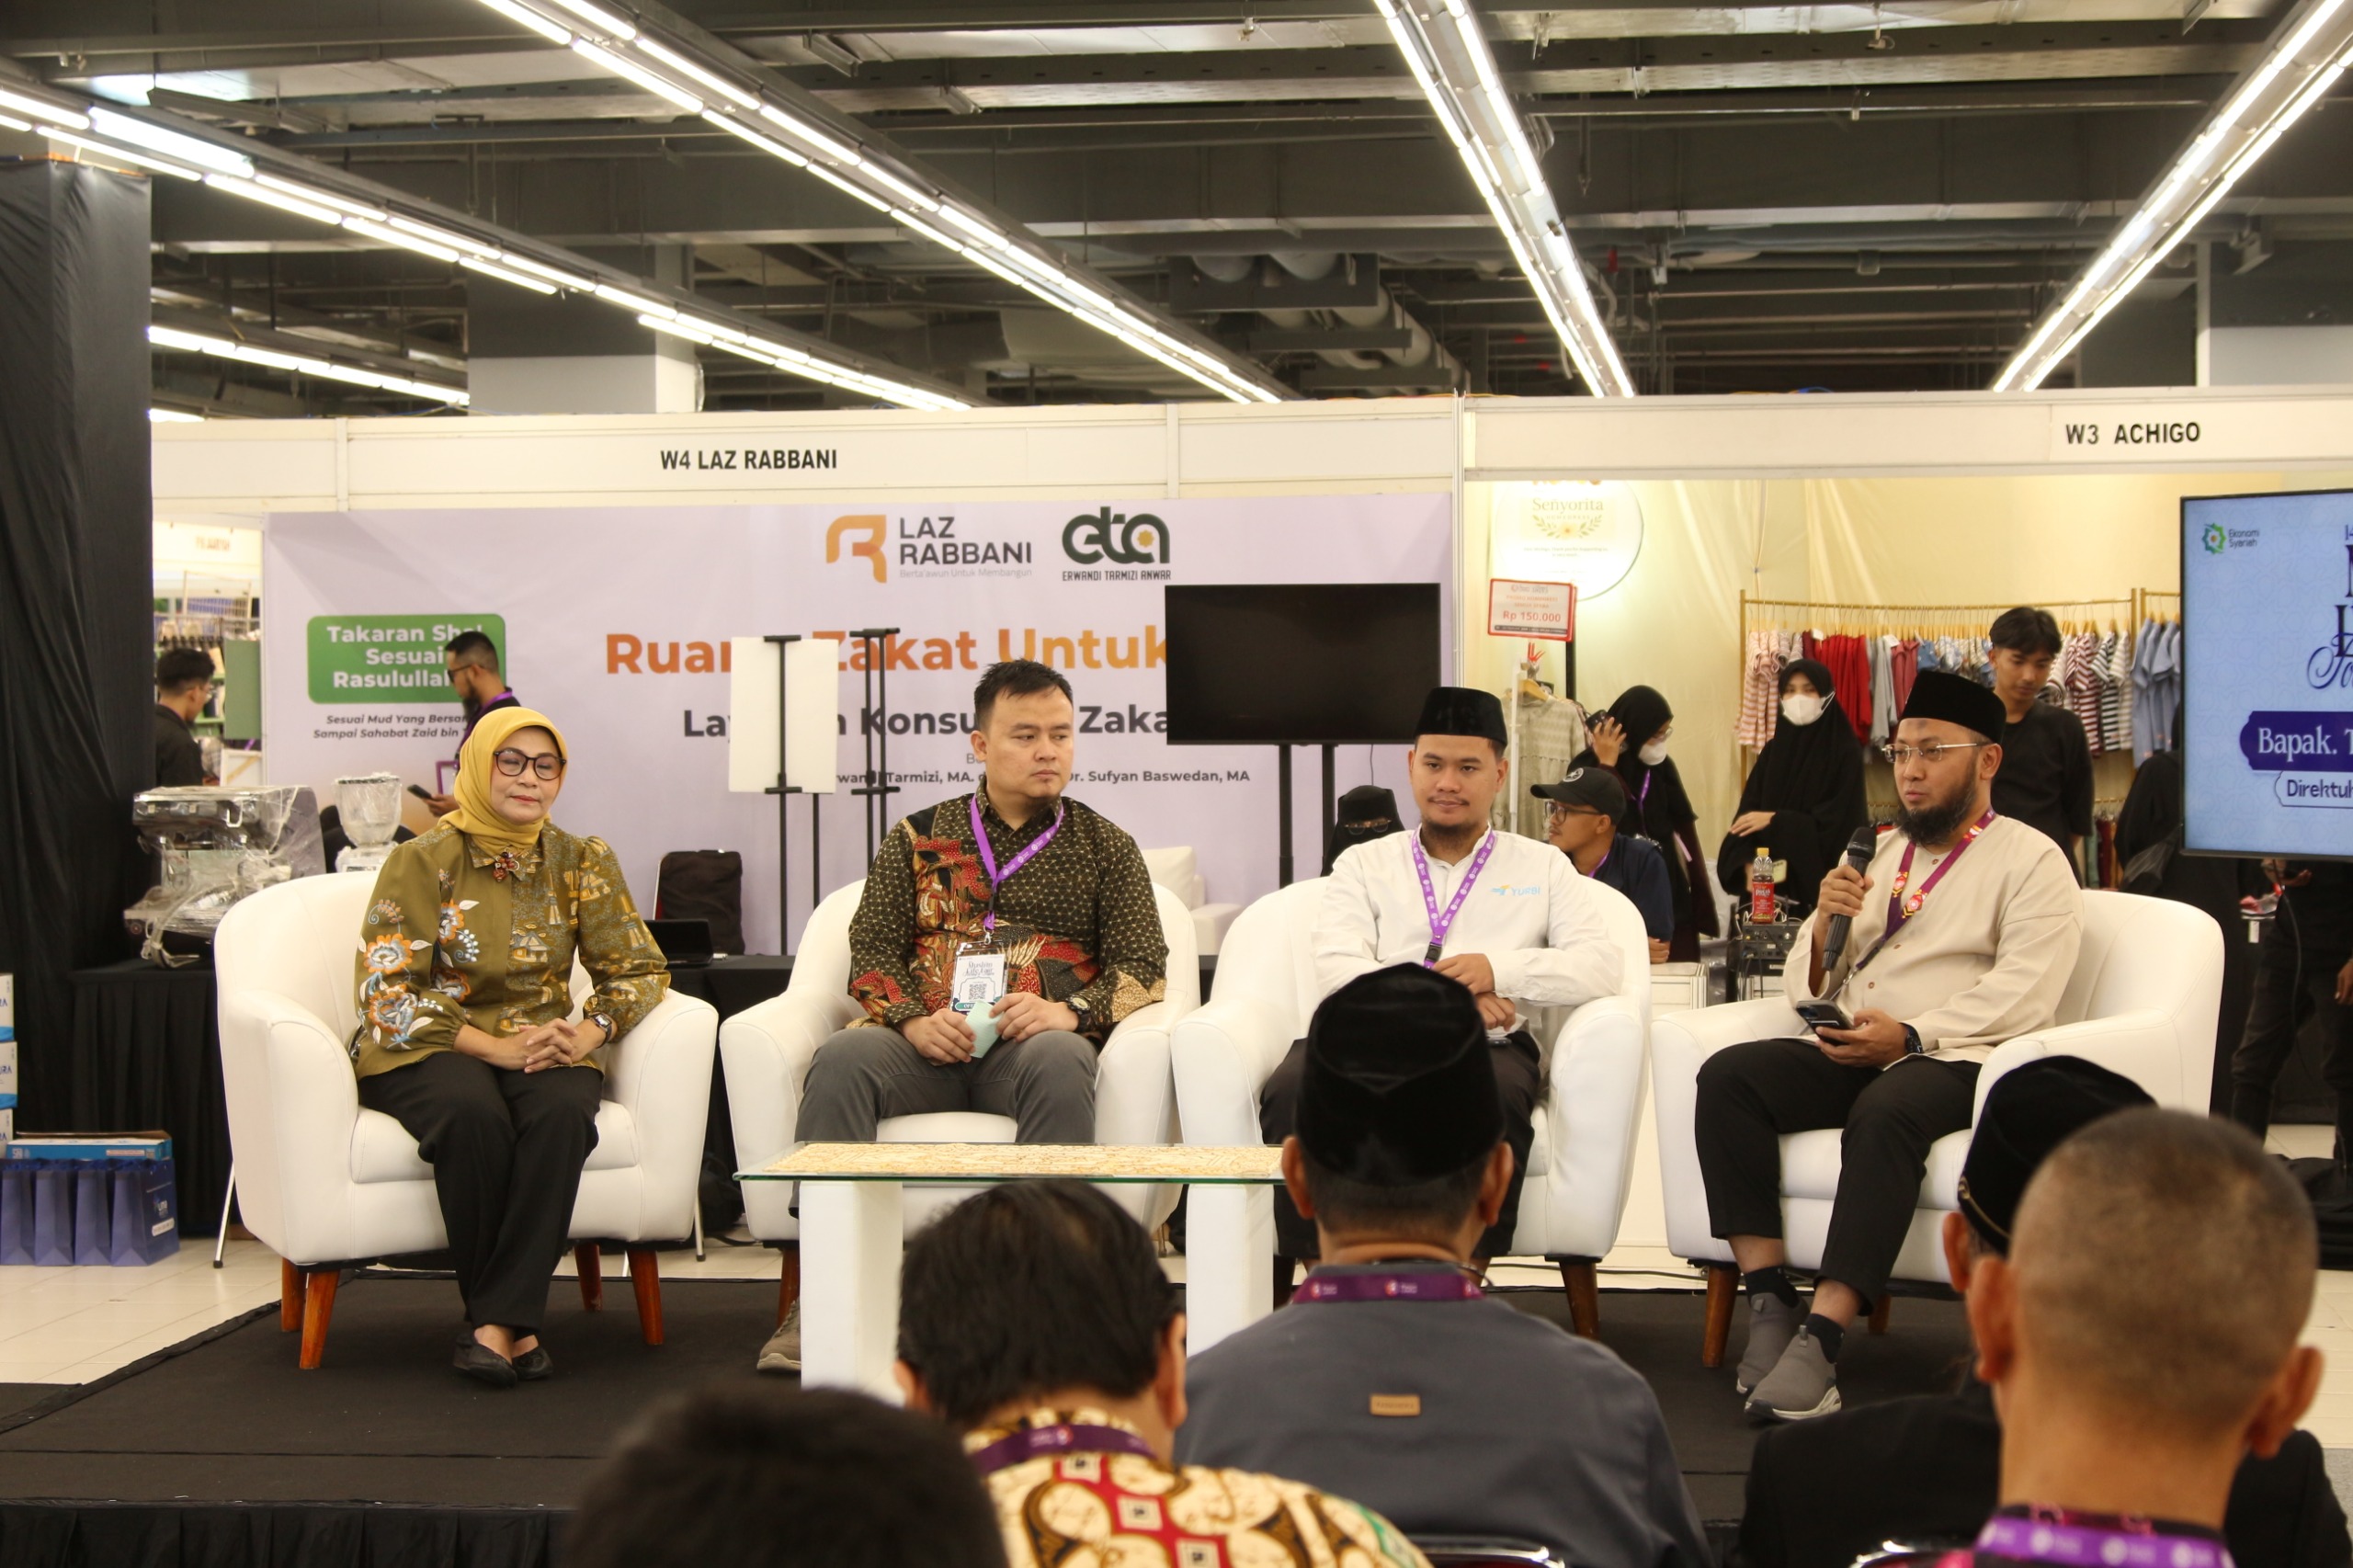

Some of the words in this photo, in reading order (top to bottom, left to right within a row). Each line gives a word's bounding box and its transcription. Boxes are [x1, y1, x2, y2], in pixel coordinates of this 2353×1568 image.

[2066, 424, 2099, 444] W3
[2114, 422, 2200, 444] ACHIGO
[661, 450, 690, 470] W4
[699, 450, 736, 470] LAZ
[745, 449, 836, 470] RABBANI
[900, 517, 955, 539] LAZ
[2229, 529, 2259, 538] Ekonomi
[900, 541, 1031, 564] RABBANI
[2229, 539, 2257, 550] Syariah
[1063, 570, 1101, 581] ERWANDI
[1105, 570, 1137, 581] TARMIZI
[1141, 569, 1171, 581] ANWAR
[1503, 610, 1517, 621] Rp
[1520, 611, 1562, 622] 150.000
[327, 626, 425, 643] Takaran
[366, 645, 444, 665] Sesuai
[326, 714, 364, 724] Sesuai
[368, 714, 392, 724] Mud
[396, 714, 425, 725] Yang
[1079, 704, 1167, 733] Zaka
[313, 729, 357, 740] Sampai
[360, 728, 408, 738] Sahabat
[413, 727, 438, 738] Zaid
[440, 727, 459, 737] bin
[2257, 724, 2338, 762] Bapak.
[886, 770, 943, 784] Tarmizi,
[948, 771, 974, 782] MA.
[1088, 770, 1138, 784] Sufyan
[1142, 770, 1222, 783] Baswedan,
[1227, 770, 1250, 781] MA
